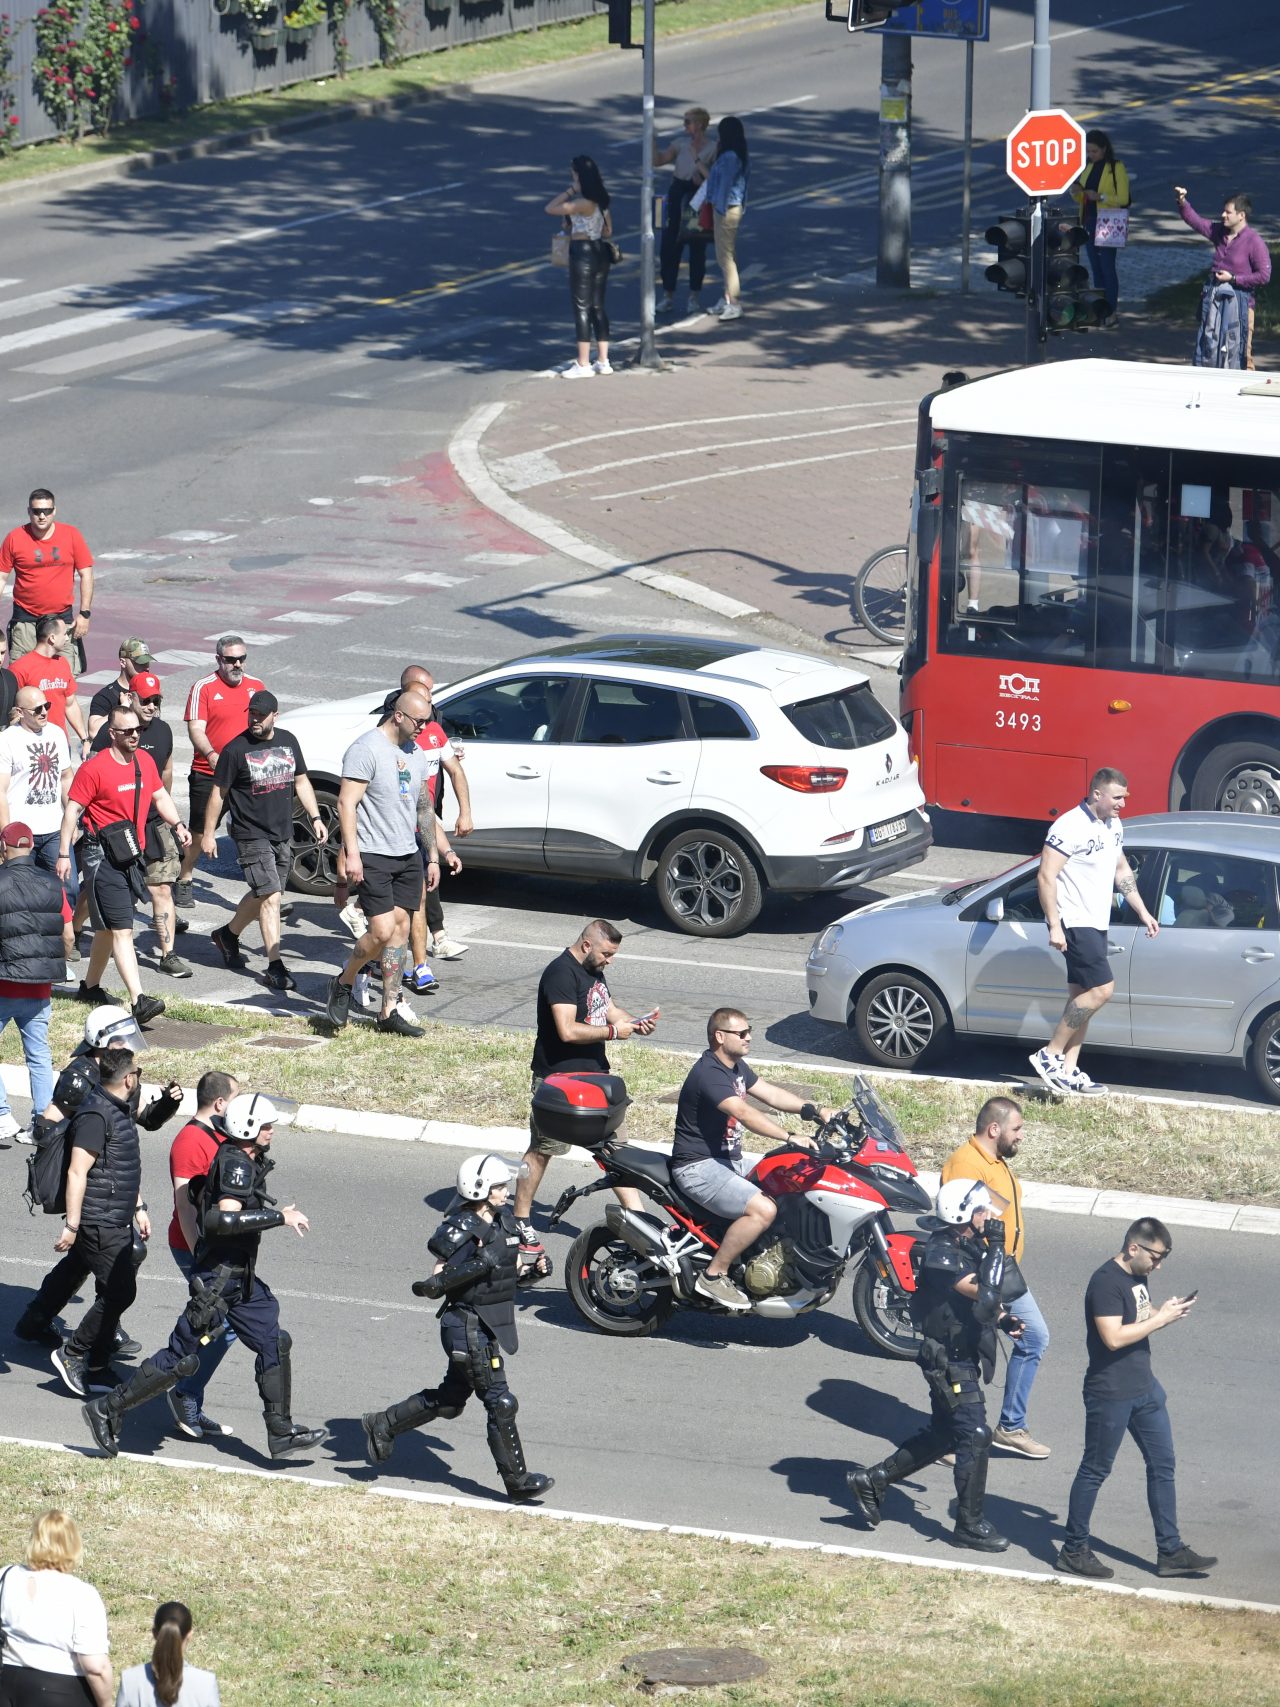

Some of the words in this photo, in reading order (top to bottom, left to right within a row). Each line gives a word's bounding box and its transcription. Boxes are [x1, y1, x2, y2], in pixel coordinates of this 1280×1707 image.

[1017, 138, 1077, 168] STOP
[999, 673, 1040, 695] ГСП
[995, 711, 1041, 731] 3493
[875, 773, 900, 786] KADJAR
